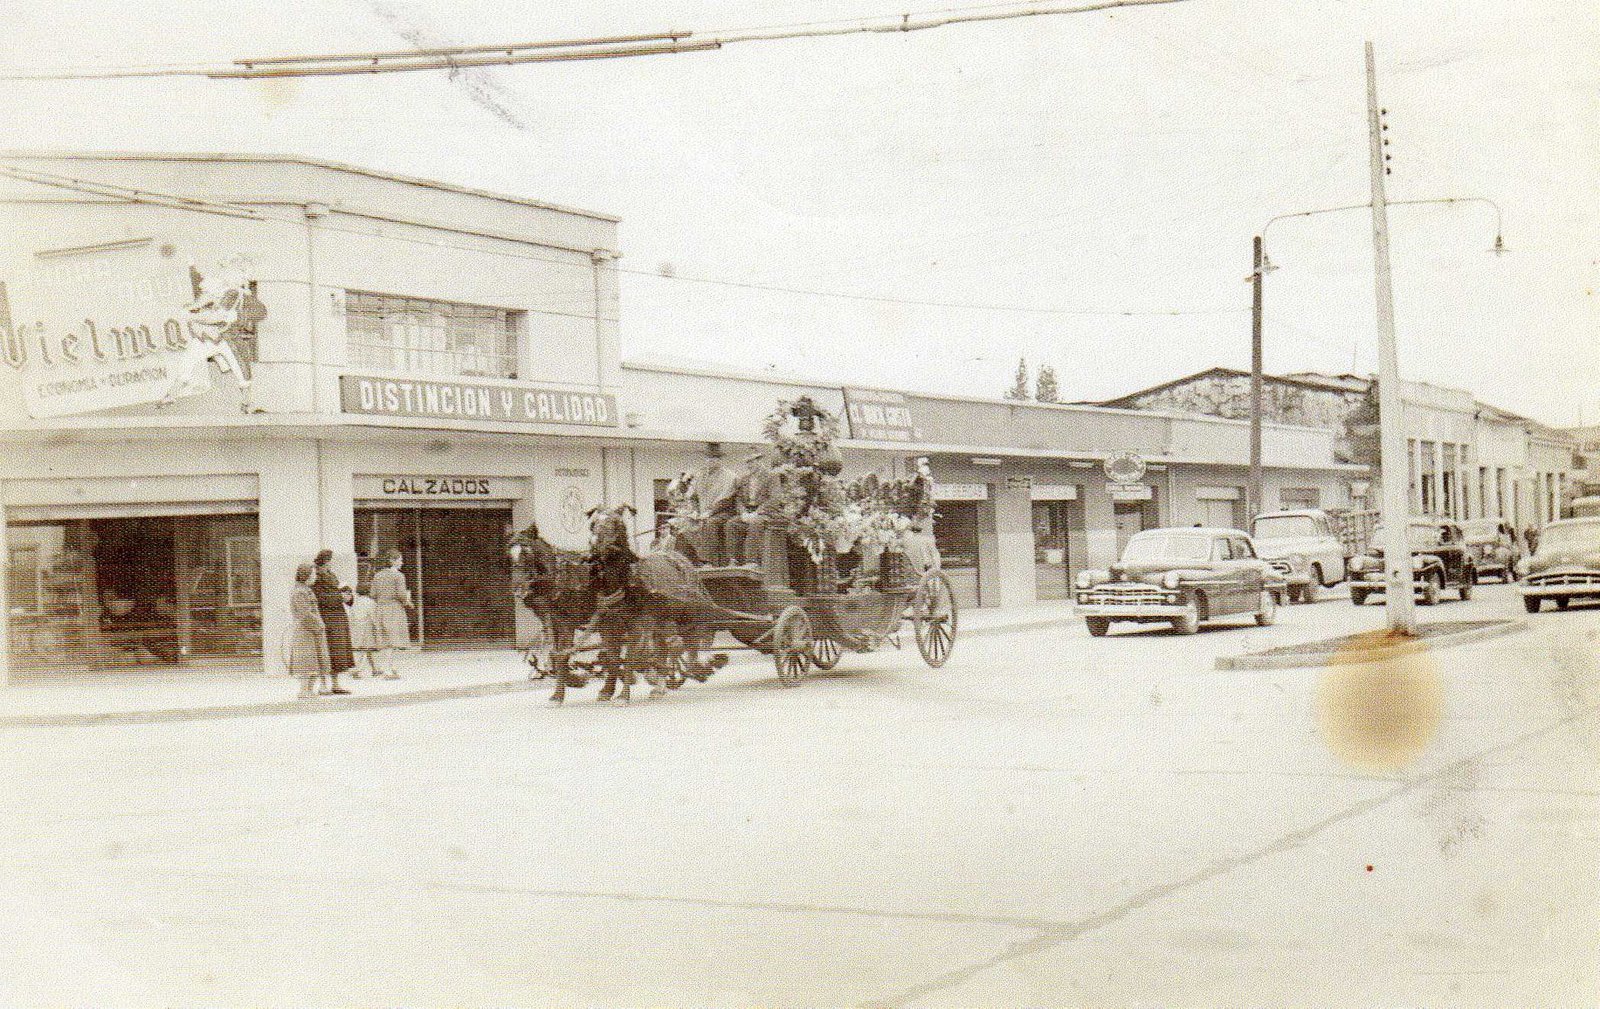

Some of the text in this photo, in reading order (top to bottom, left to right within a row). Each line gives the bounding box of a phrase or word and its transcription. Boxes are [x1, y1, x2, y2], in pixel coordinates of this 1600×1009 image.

[0, 281, 188, 370] Vielma
[360, 380, 608, 422] DISTINCION Y CALIDAD
[383, 479, 491, 495] CALZADOS
